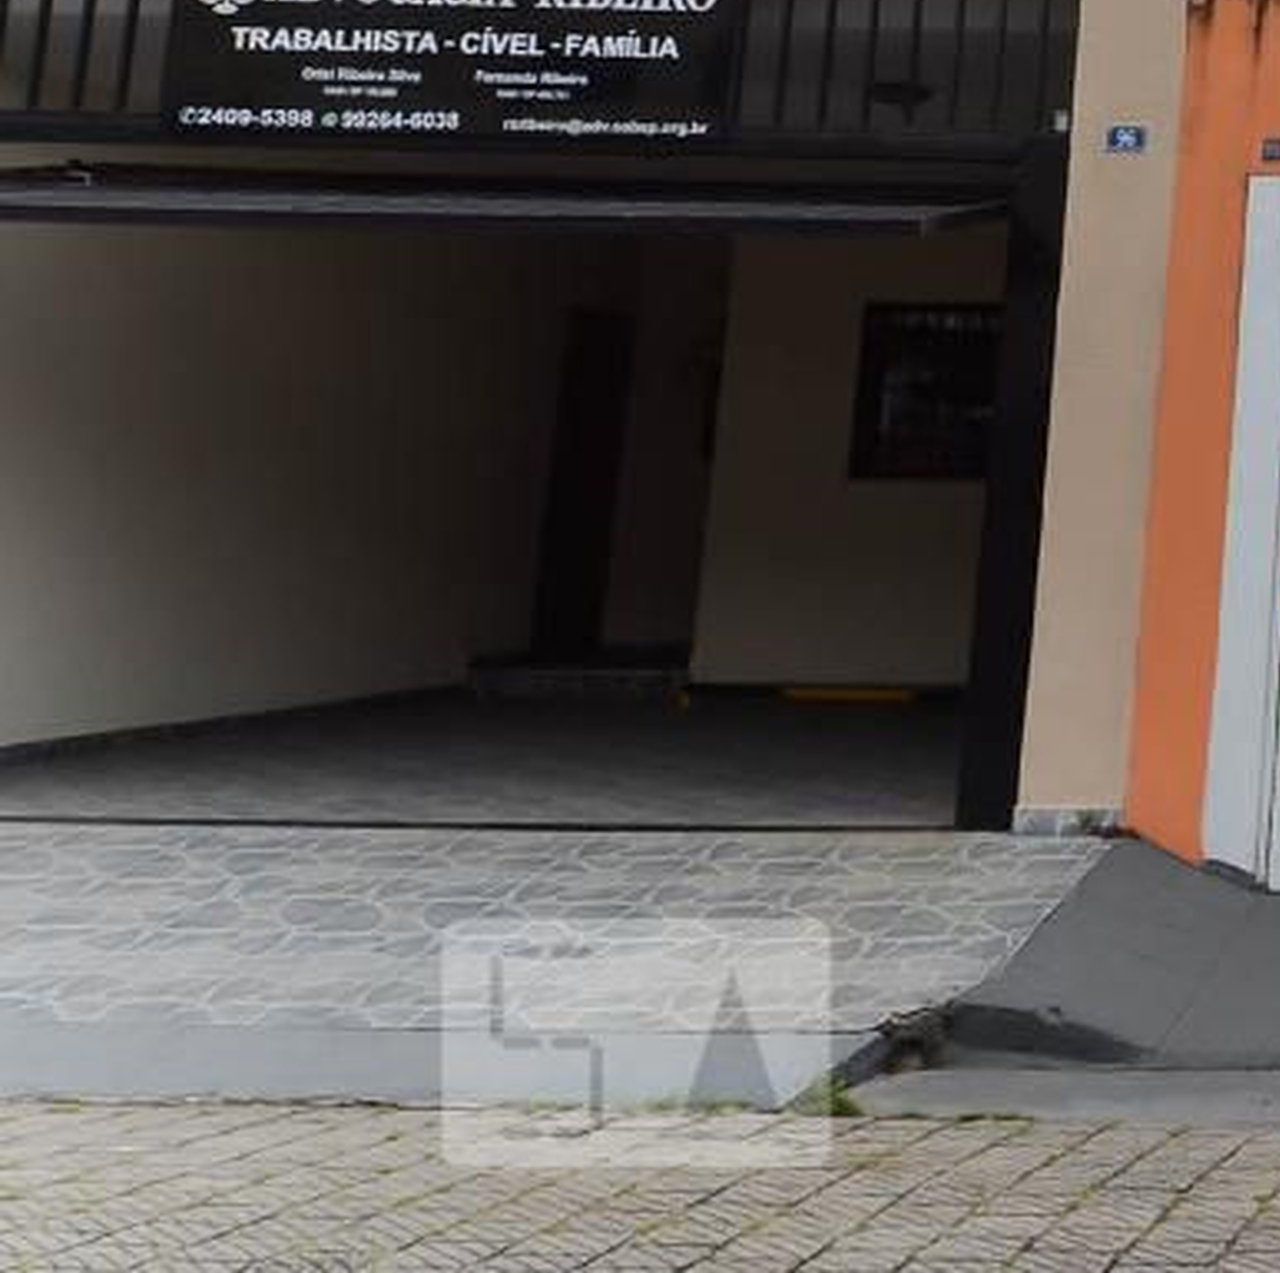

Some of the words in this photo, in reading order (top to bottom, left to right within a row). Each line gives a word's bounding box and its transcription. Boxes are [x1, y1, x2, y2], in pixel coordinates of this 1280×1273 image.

[232, 27, 438, 54] TRABALHISTA
[460, 26, 545, 56] CÍVEL
[564, 29, 680, 59] FAMÍLIA
